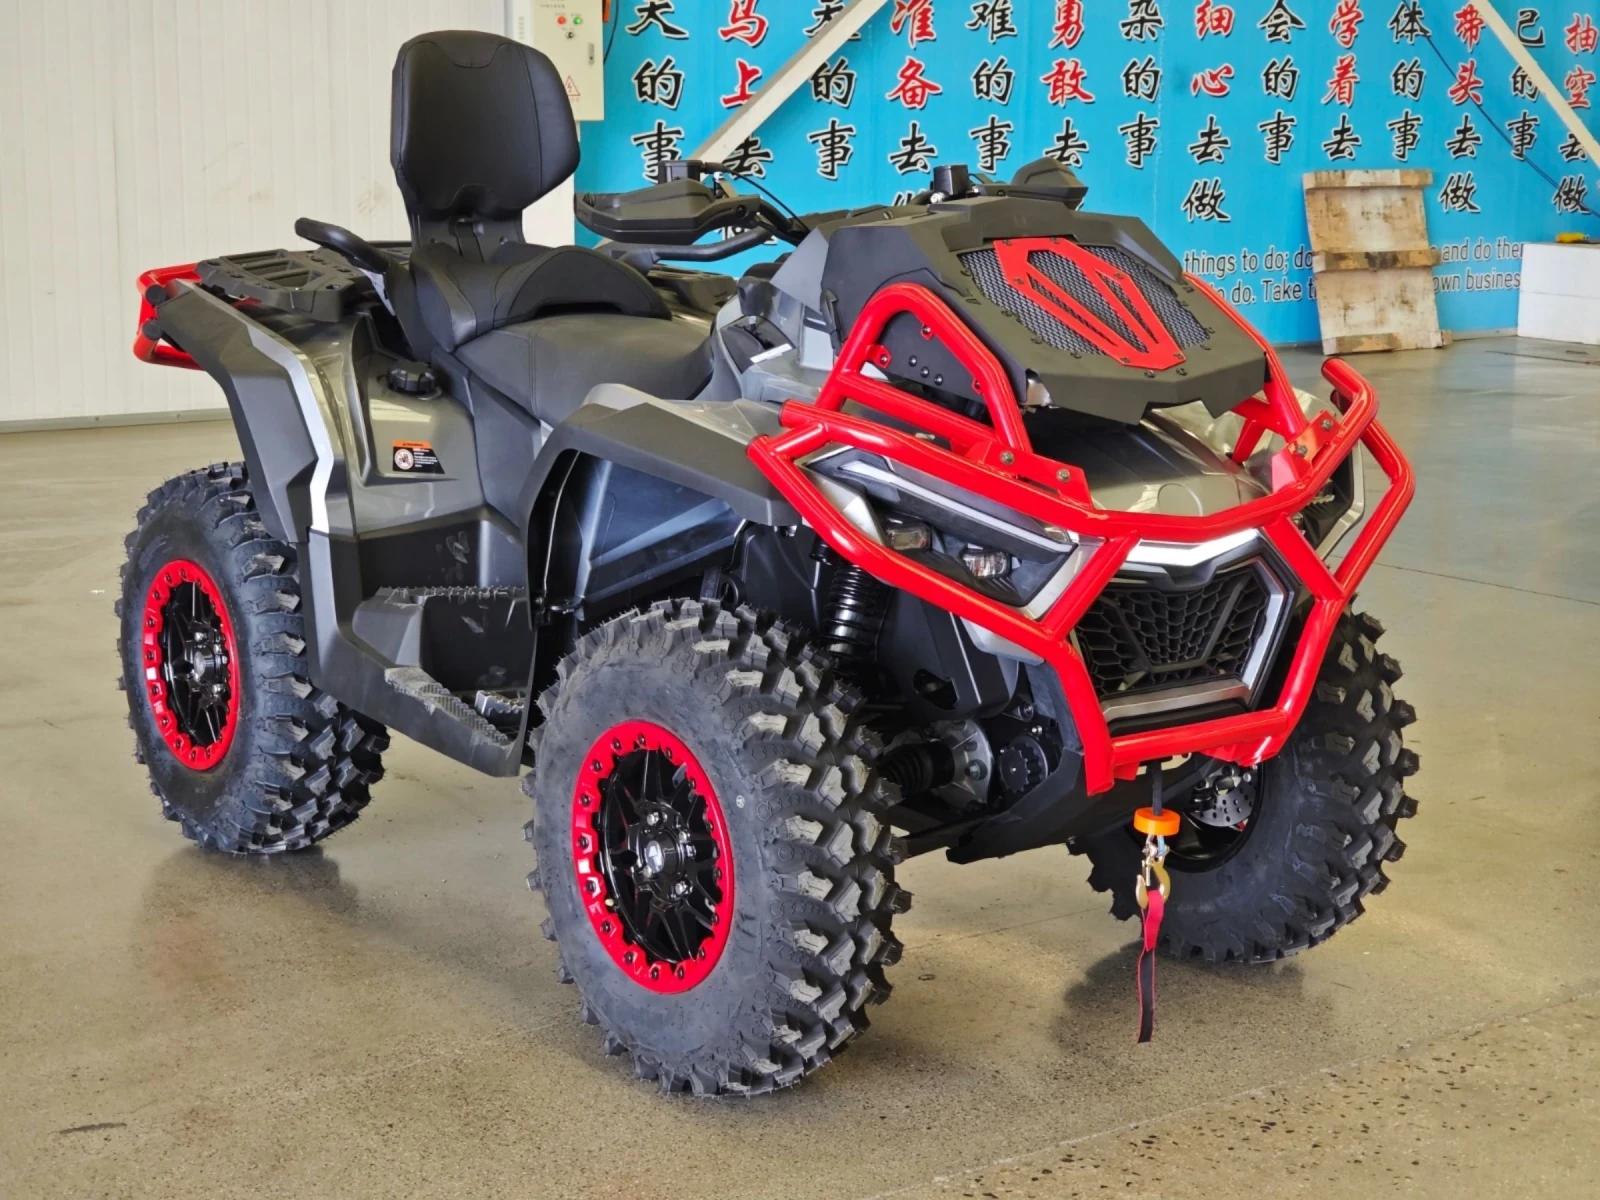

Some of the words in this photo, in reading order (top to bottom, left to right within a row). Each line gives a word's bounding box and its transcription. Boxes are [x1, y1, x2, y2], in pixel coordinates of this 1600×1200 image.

[967, 0, 1017, 174] 难的事
[1181, 0, 1234, 222] 细心去做
[1258, 0, 1306, 164] 会的事
[1387, 1, 1431, 162] 体的事
[1438, 3, 1484, 213] 带头去做
[1184, 250, 1236, 279] things
[1242, 248, 1258, 271] to
[1265, 245, 1289, 274] do;
[1231, 279, 1256, 304] do.
[1262, 278, 1302, 301] Take
[1442, 238, 1468, 262] and
[1474, 237, 1491, 260] do
